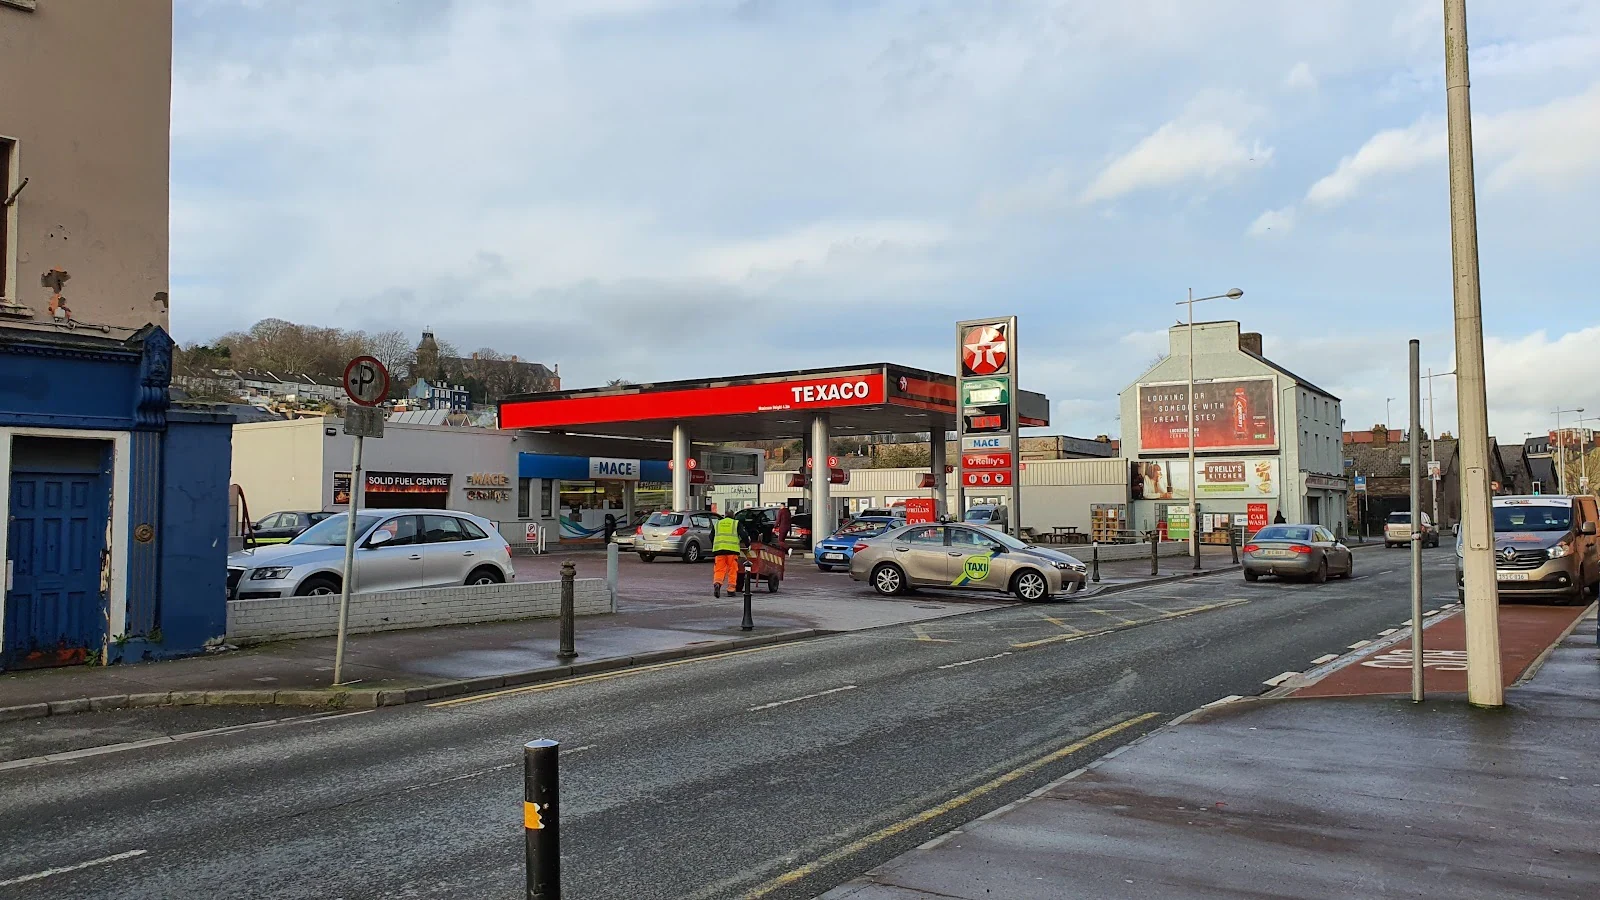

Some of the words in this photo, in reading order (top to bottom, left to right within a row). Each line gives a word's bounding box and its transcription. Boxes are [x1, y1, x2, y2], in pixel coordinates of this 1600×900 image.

[791, 381, 869, 403] TEXACO
[1148, 393, 1184, 402] LOOKING
[1194, 392, 1205, 400] OR
[1154, 415, 1179, 423] GREAT
[973, 438, 999, 447] MACE
[968, 458, 1004, 466] O'Reilly's
[599, 462, 632, 475] MACE
[369, 476, 393, 485] SOLID
[395, 477, 415, 485] FUEL
[472, 472, 505, 485] MACE
[967, 562, 988, 572] TAXI
